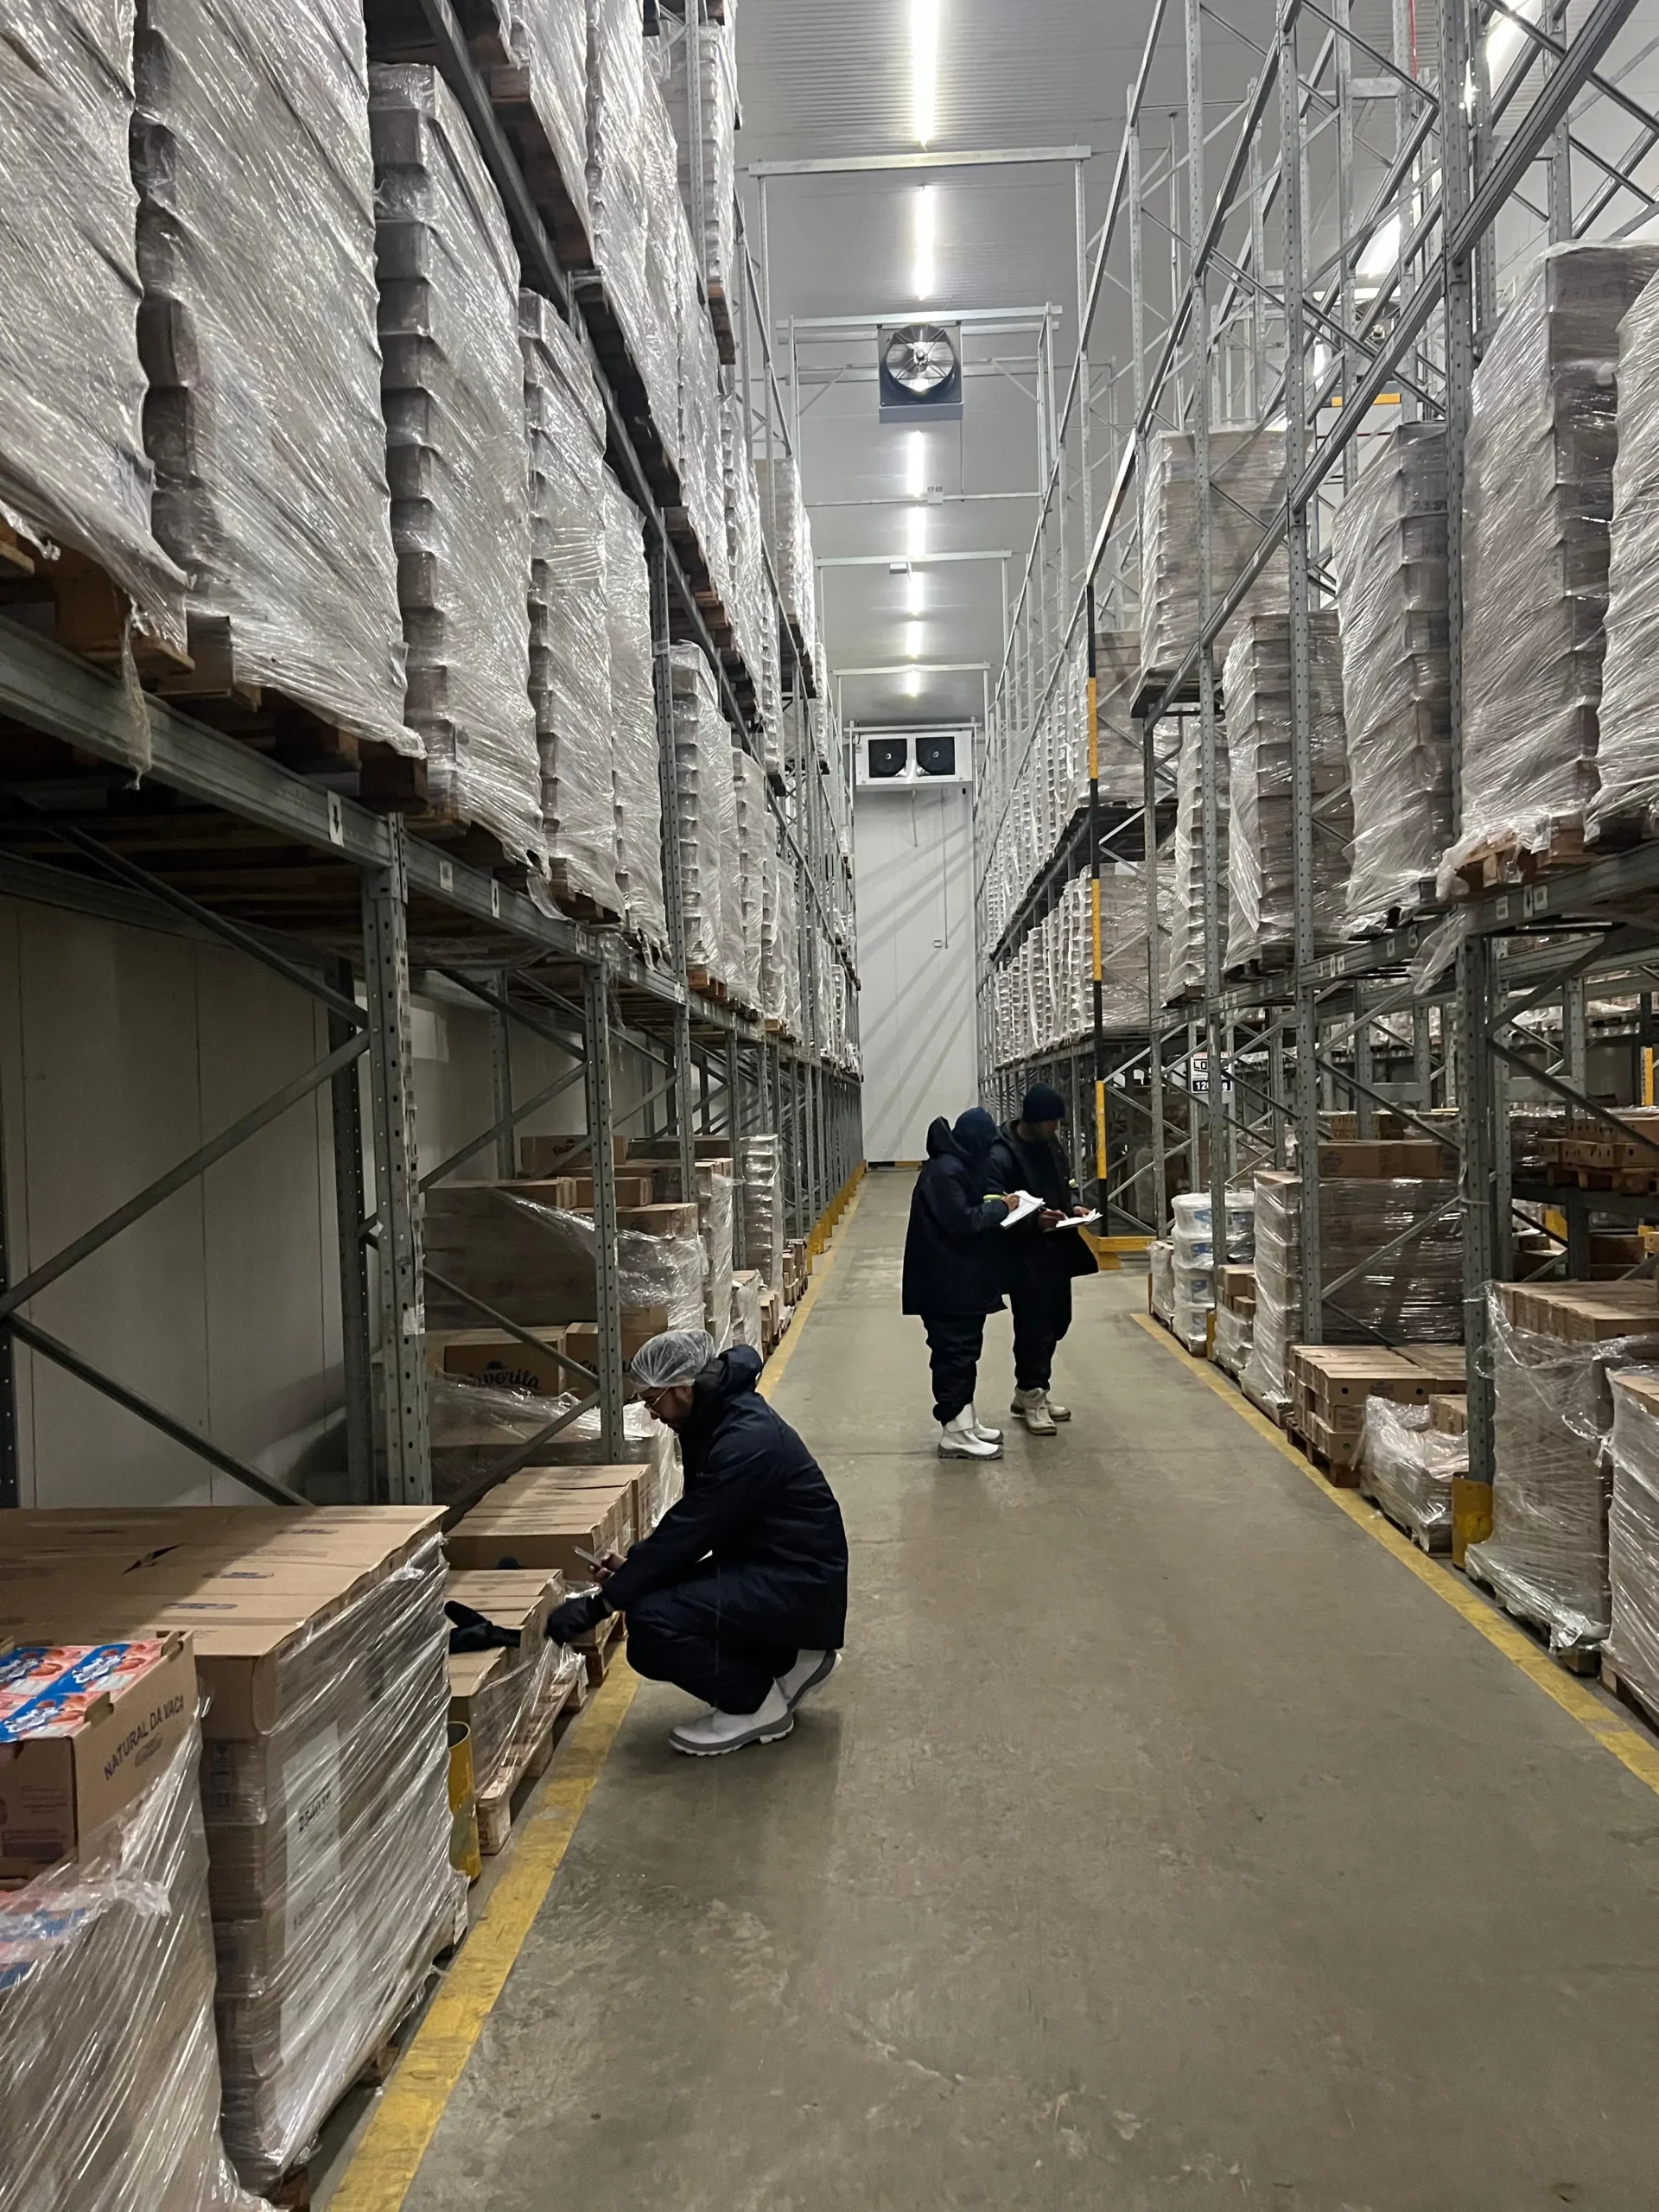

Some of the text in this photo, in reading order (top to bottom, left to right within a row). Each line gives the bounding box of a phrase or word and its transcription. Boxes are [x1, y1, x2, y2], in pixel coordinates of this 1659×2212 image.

[104, 1720, 149, 1781] NATURAL
[149, 1707, 163, 1732] DA
[163, 1694, 184, 1719] VACA
